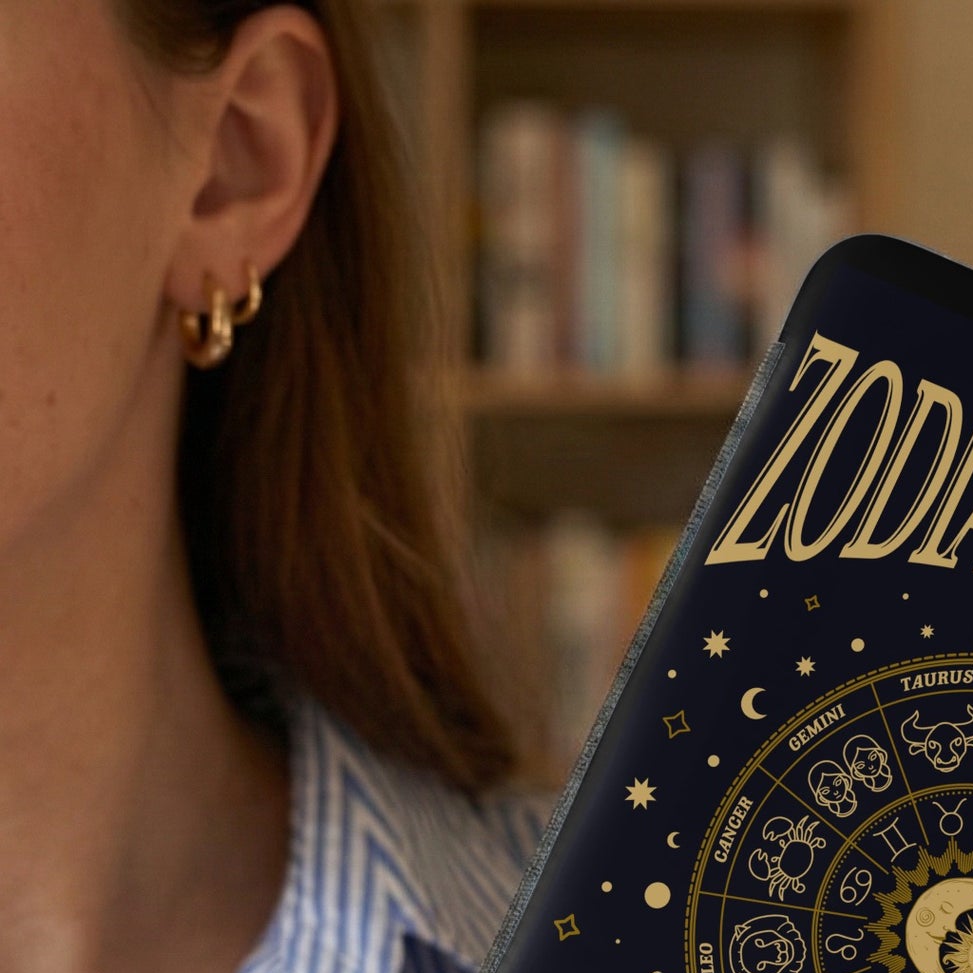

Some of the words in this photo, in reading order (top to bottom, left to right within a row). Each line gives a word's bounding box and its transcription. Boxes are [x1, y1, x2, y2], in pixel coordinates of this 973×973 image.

[901, 670, 973, 691] TAURUS
[788, 704, 846, 751] GEMINI
[714, 796, 754, 864] CANCER
